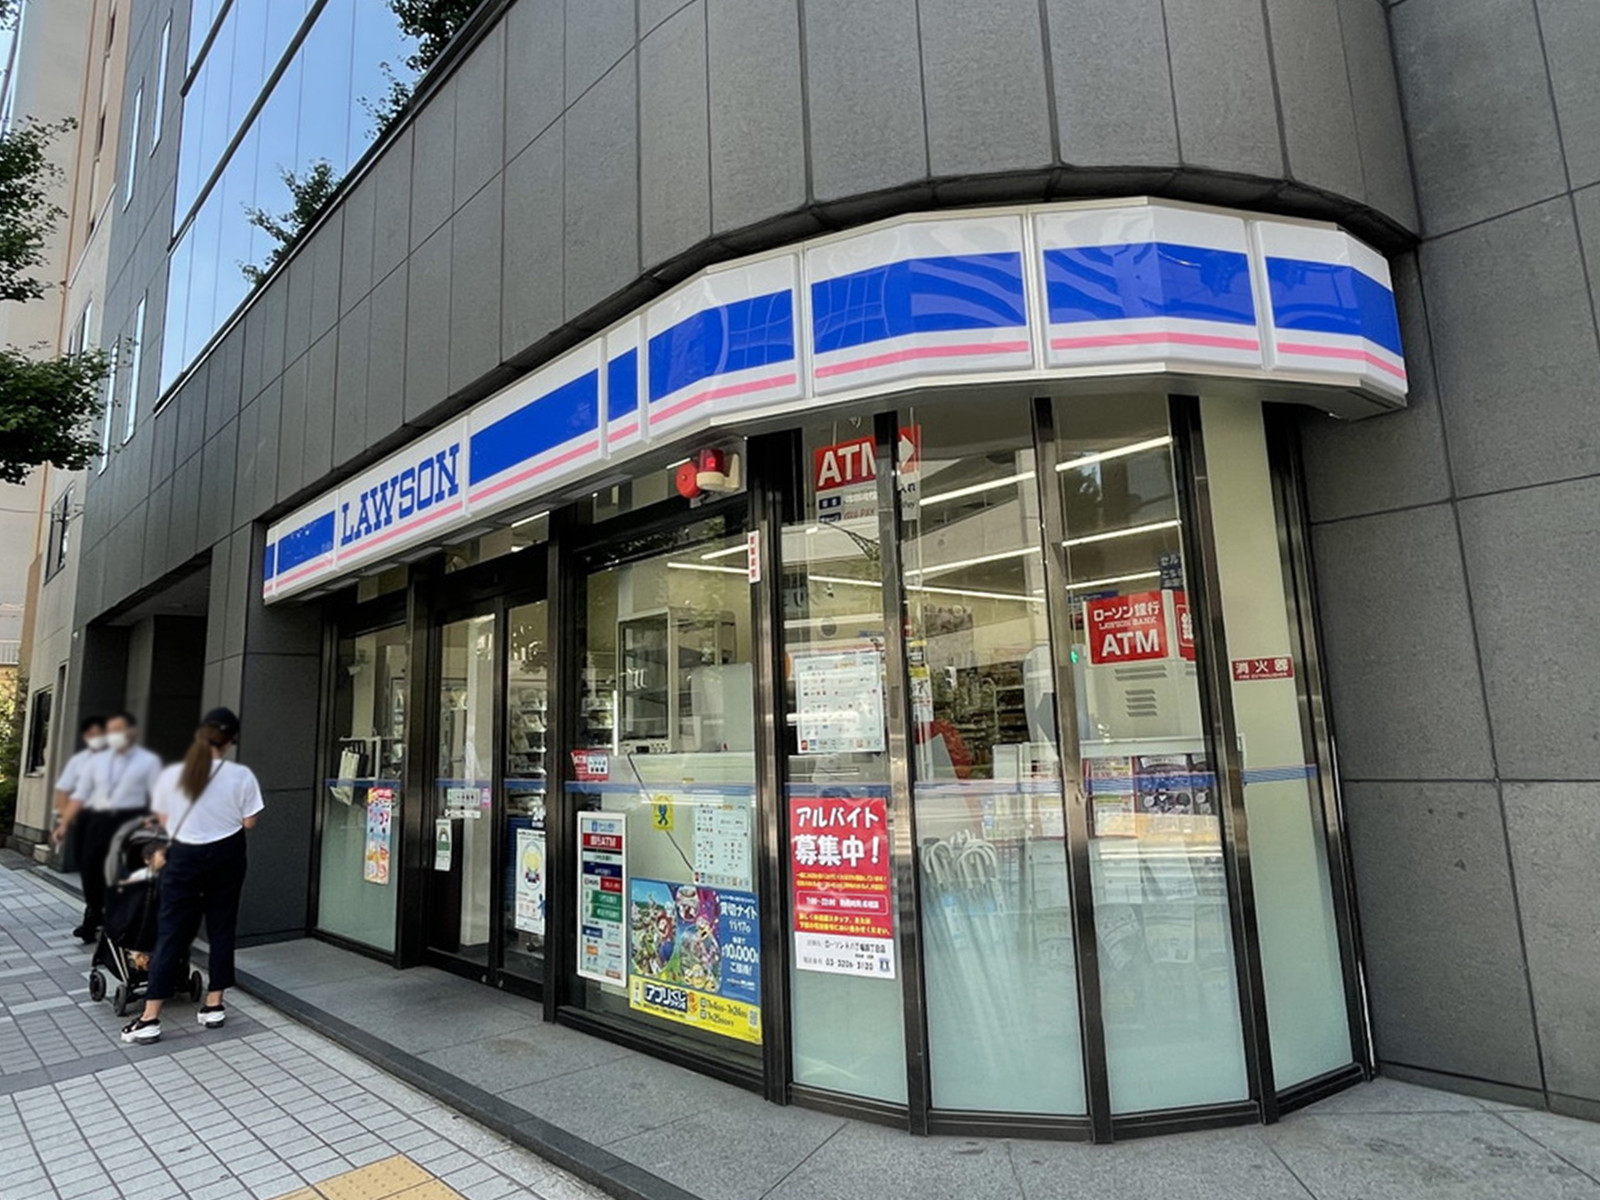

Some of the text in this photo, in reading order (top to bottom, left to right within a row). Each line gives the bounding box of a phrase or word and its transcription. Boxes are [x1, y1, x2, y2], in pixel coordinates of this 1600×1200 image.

[341, 442, 459, 547] LAWSON
[1093, 601, 1160, 622] ローソン銀行
[1132, 616, 1157, 626] BANK
[1101, 629, 1159, 657] ATM
[1236, 659, 1289, 674] 消火器
[796, 806, 879, 829] アルバイト
[794, 834, 880, 868] 募集中！
